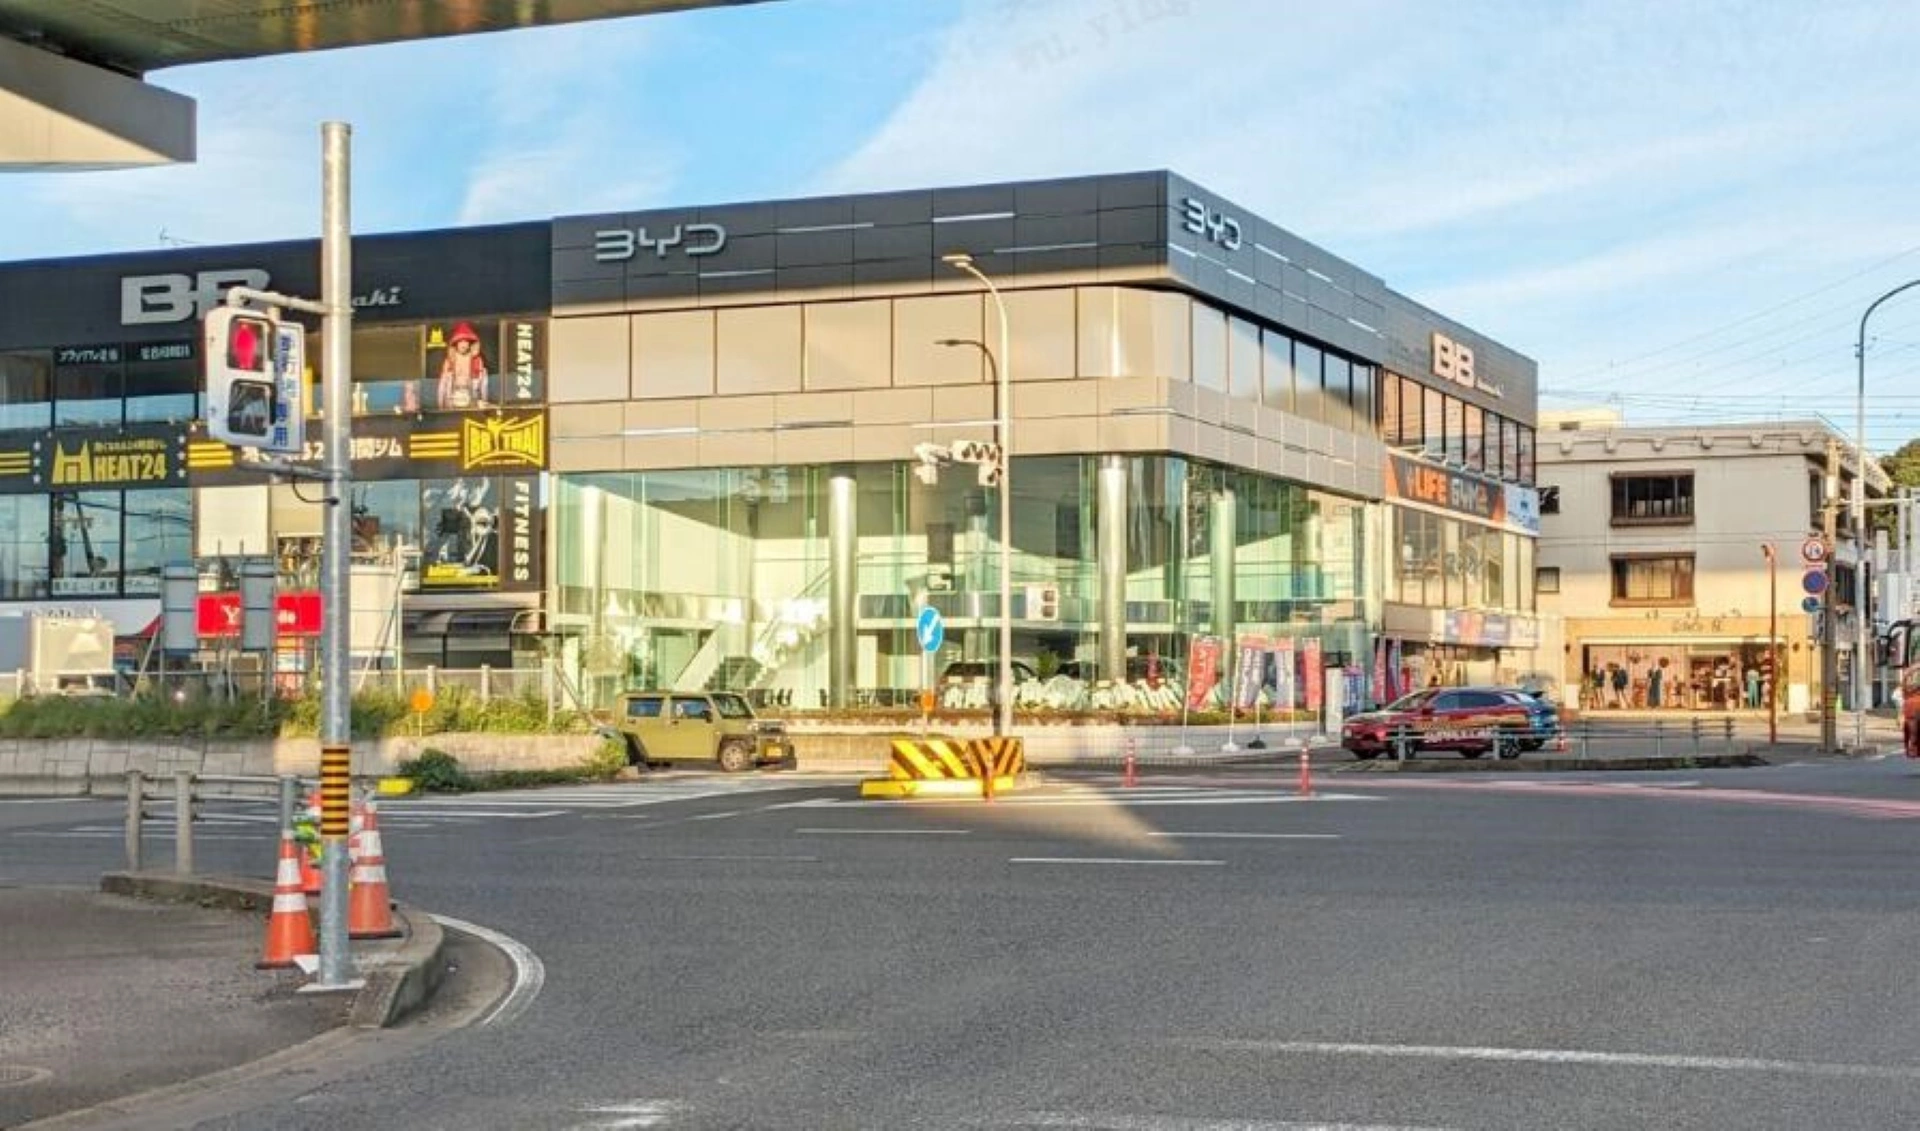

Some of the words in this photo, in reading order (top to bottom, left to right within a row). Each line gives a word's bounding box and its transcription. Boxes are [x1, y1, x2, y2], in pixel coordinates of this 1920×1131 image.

[595, 222, 727, 263] BYD
[1182, 197, 1241, 251] BYD
[514, 323, 533, 400] HEAT24
[1430, 332, 1475, 388] BB
[92, 453, 168, 482] HEAT24
[512, 481, 531, 581] FITNESS
